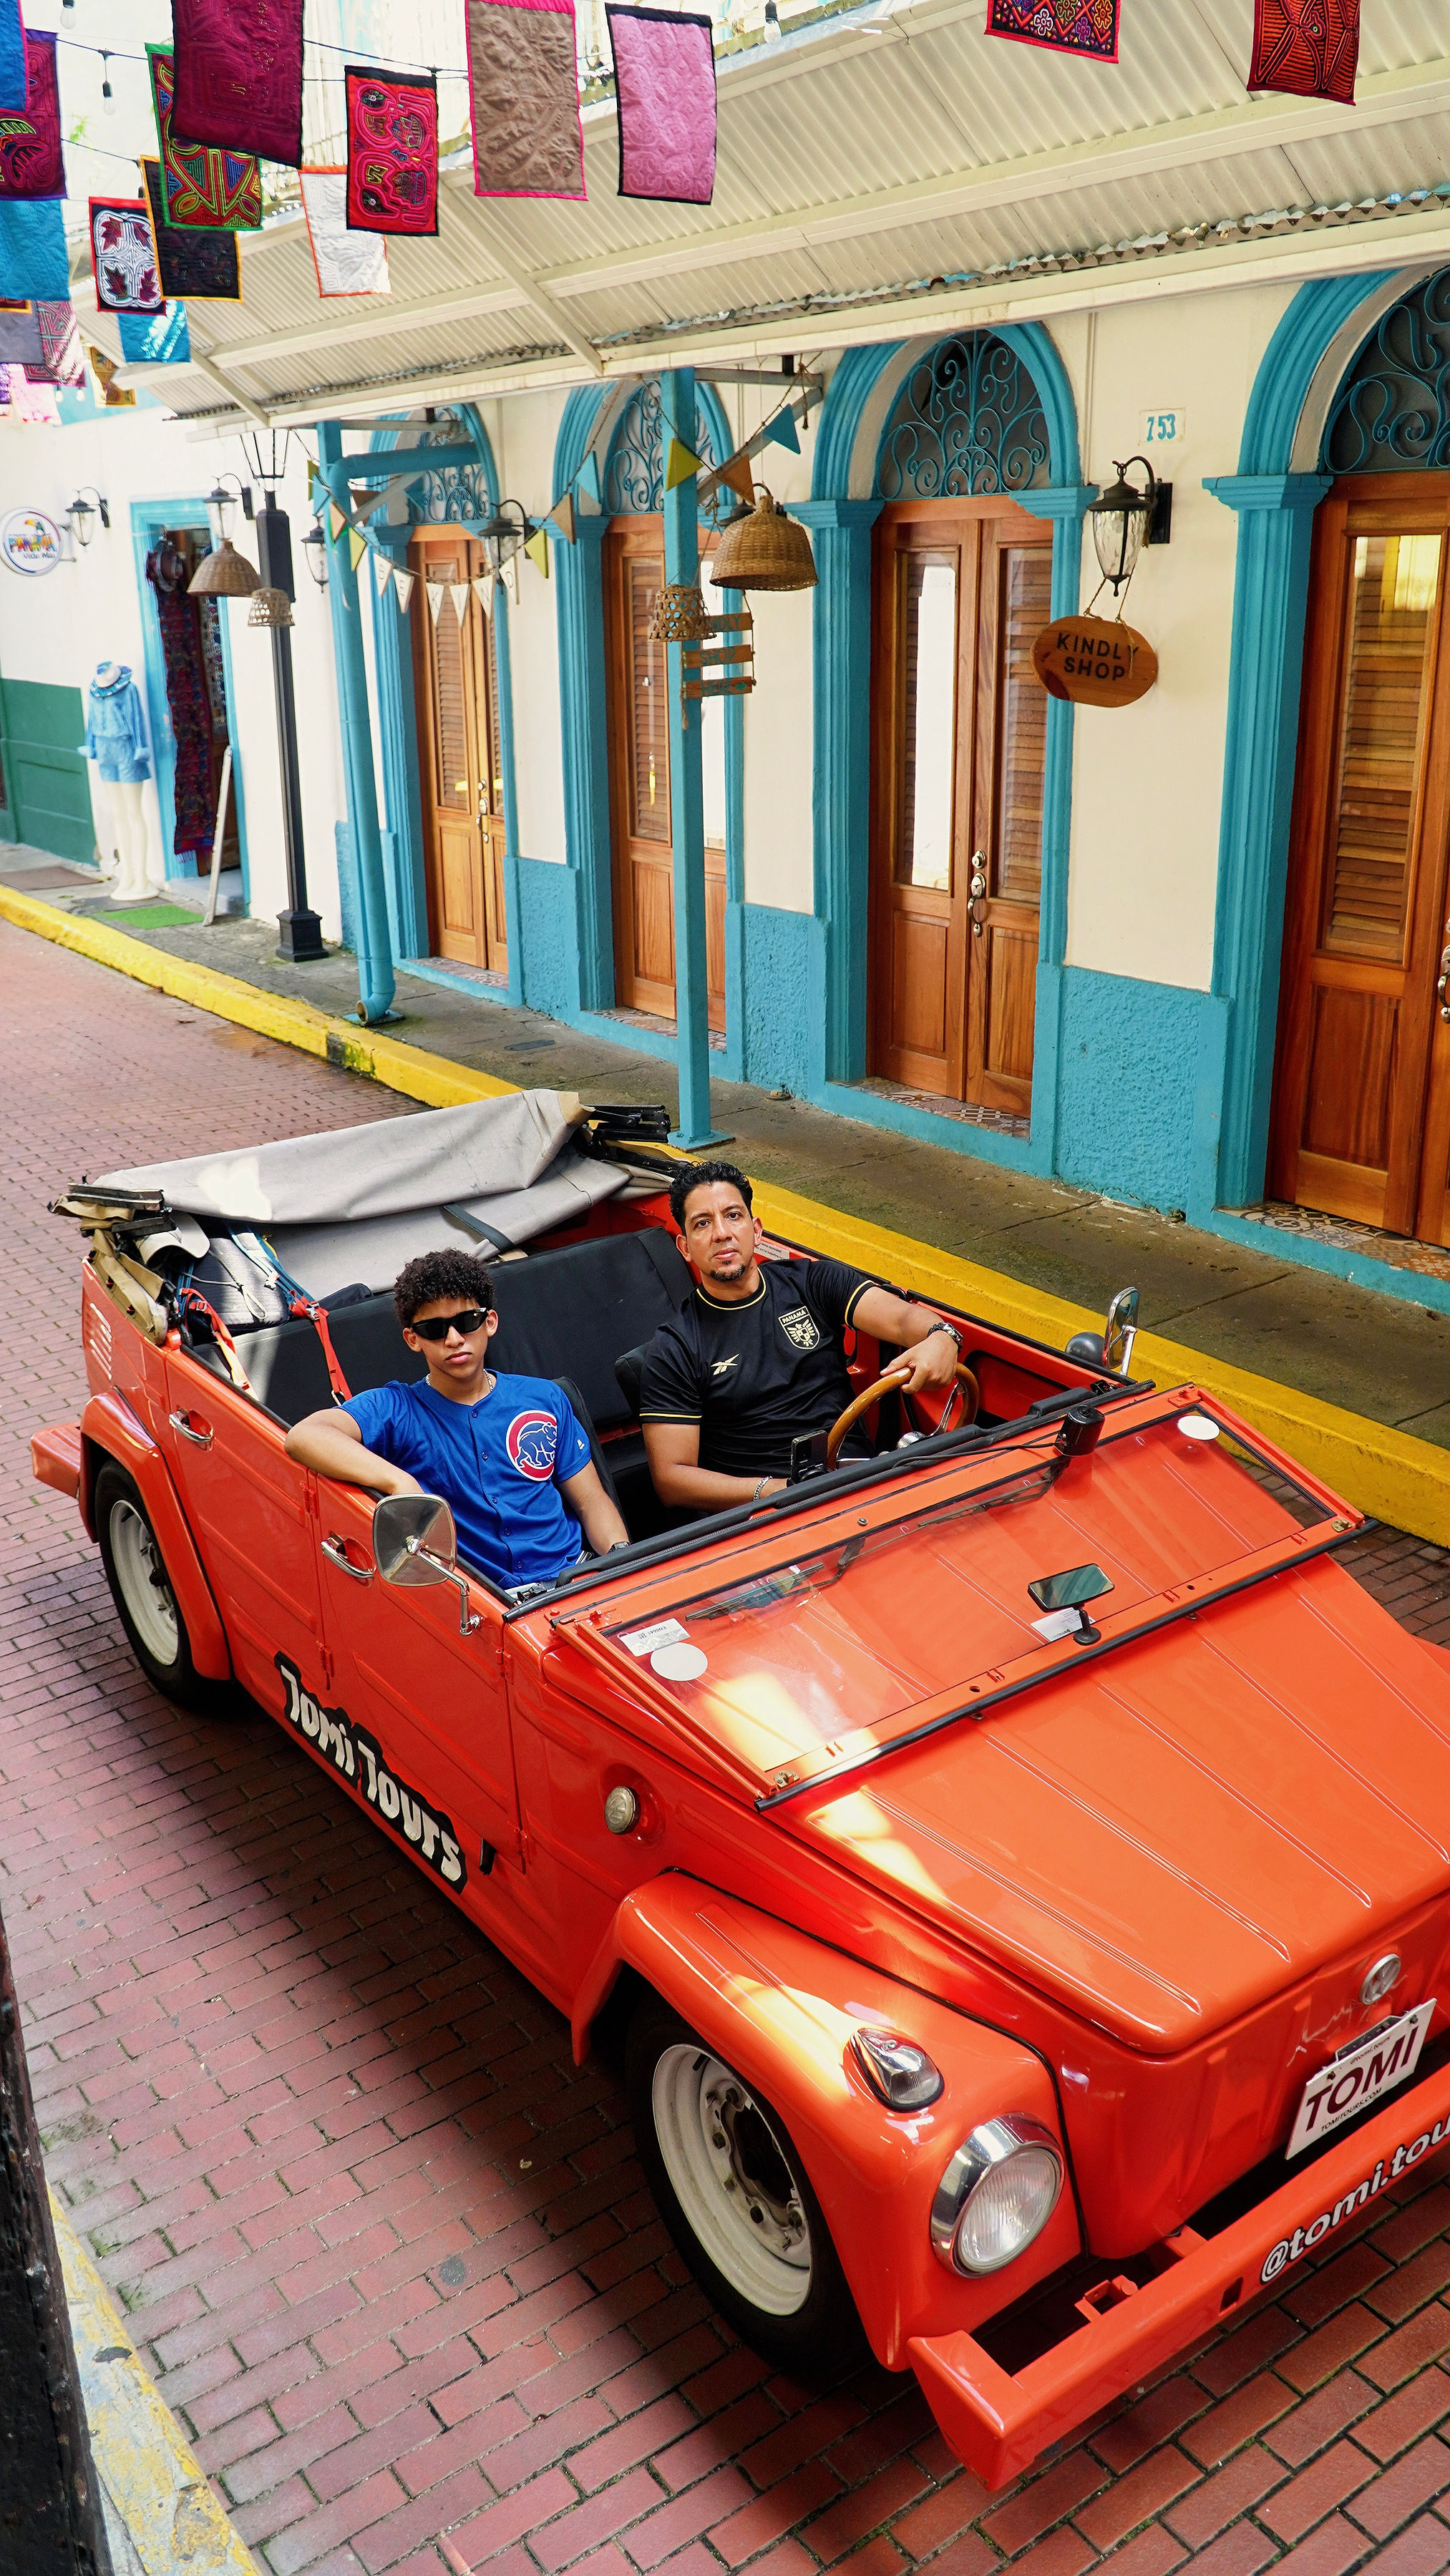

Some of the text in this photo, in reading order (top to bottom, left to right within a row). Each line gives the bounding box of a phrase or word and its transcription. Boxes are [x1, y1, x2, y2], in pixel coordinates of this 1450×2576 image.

[1147, 414, 1176, 441] 753
[700, 646, 736, 667] SHOP
[1056, 633, 1139, 662] KINDLY
[1064, 656, 1125, 680] SHOP
[701, 678, 733, 697] HERE
[1305, 2025, 1419, 2132] TOMI
[1321, 2087, 1382, 2132] TOMITOURS.COM
